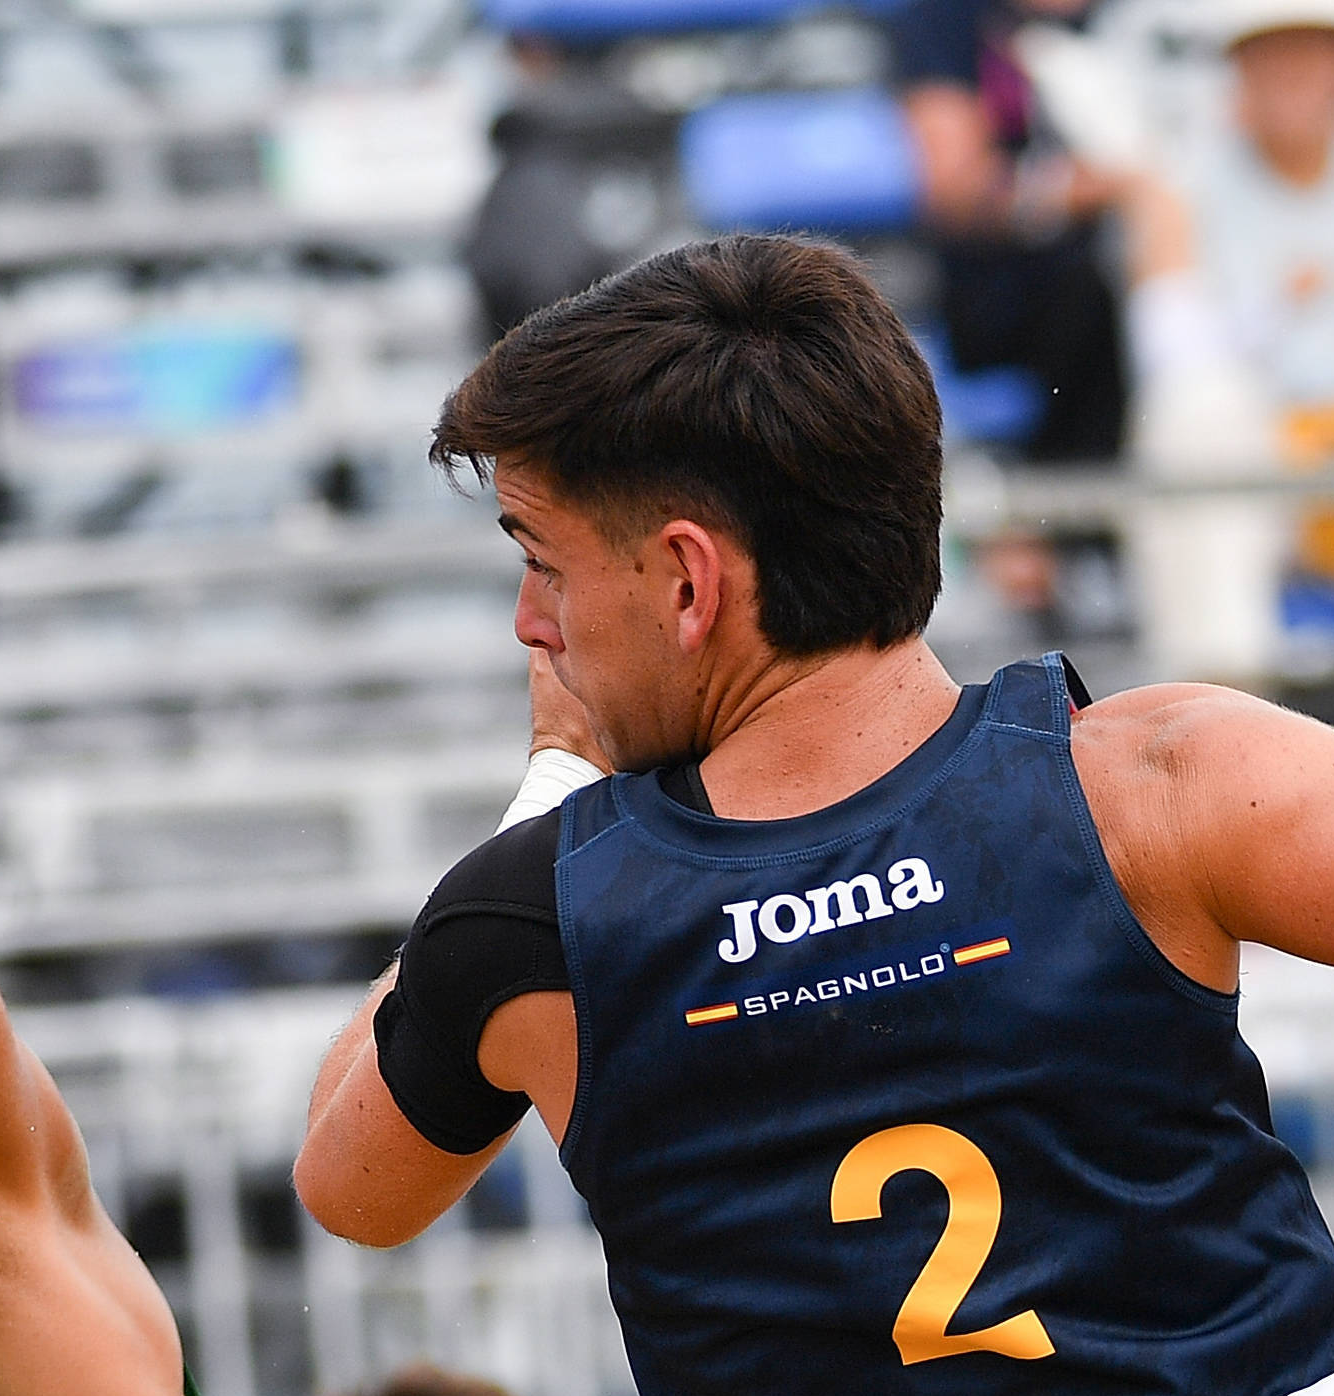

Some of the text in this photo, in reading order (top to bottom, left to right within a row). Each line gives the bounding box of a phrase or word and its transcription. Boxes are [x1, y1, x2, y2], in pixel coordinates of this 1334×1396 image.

[718, 857, 944, 963] Joma
[743, 953, 945, 1016] SPAGNOLO
[830, 1123, 1056, 1366] 2
